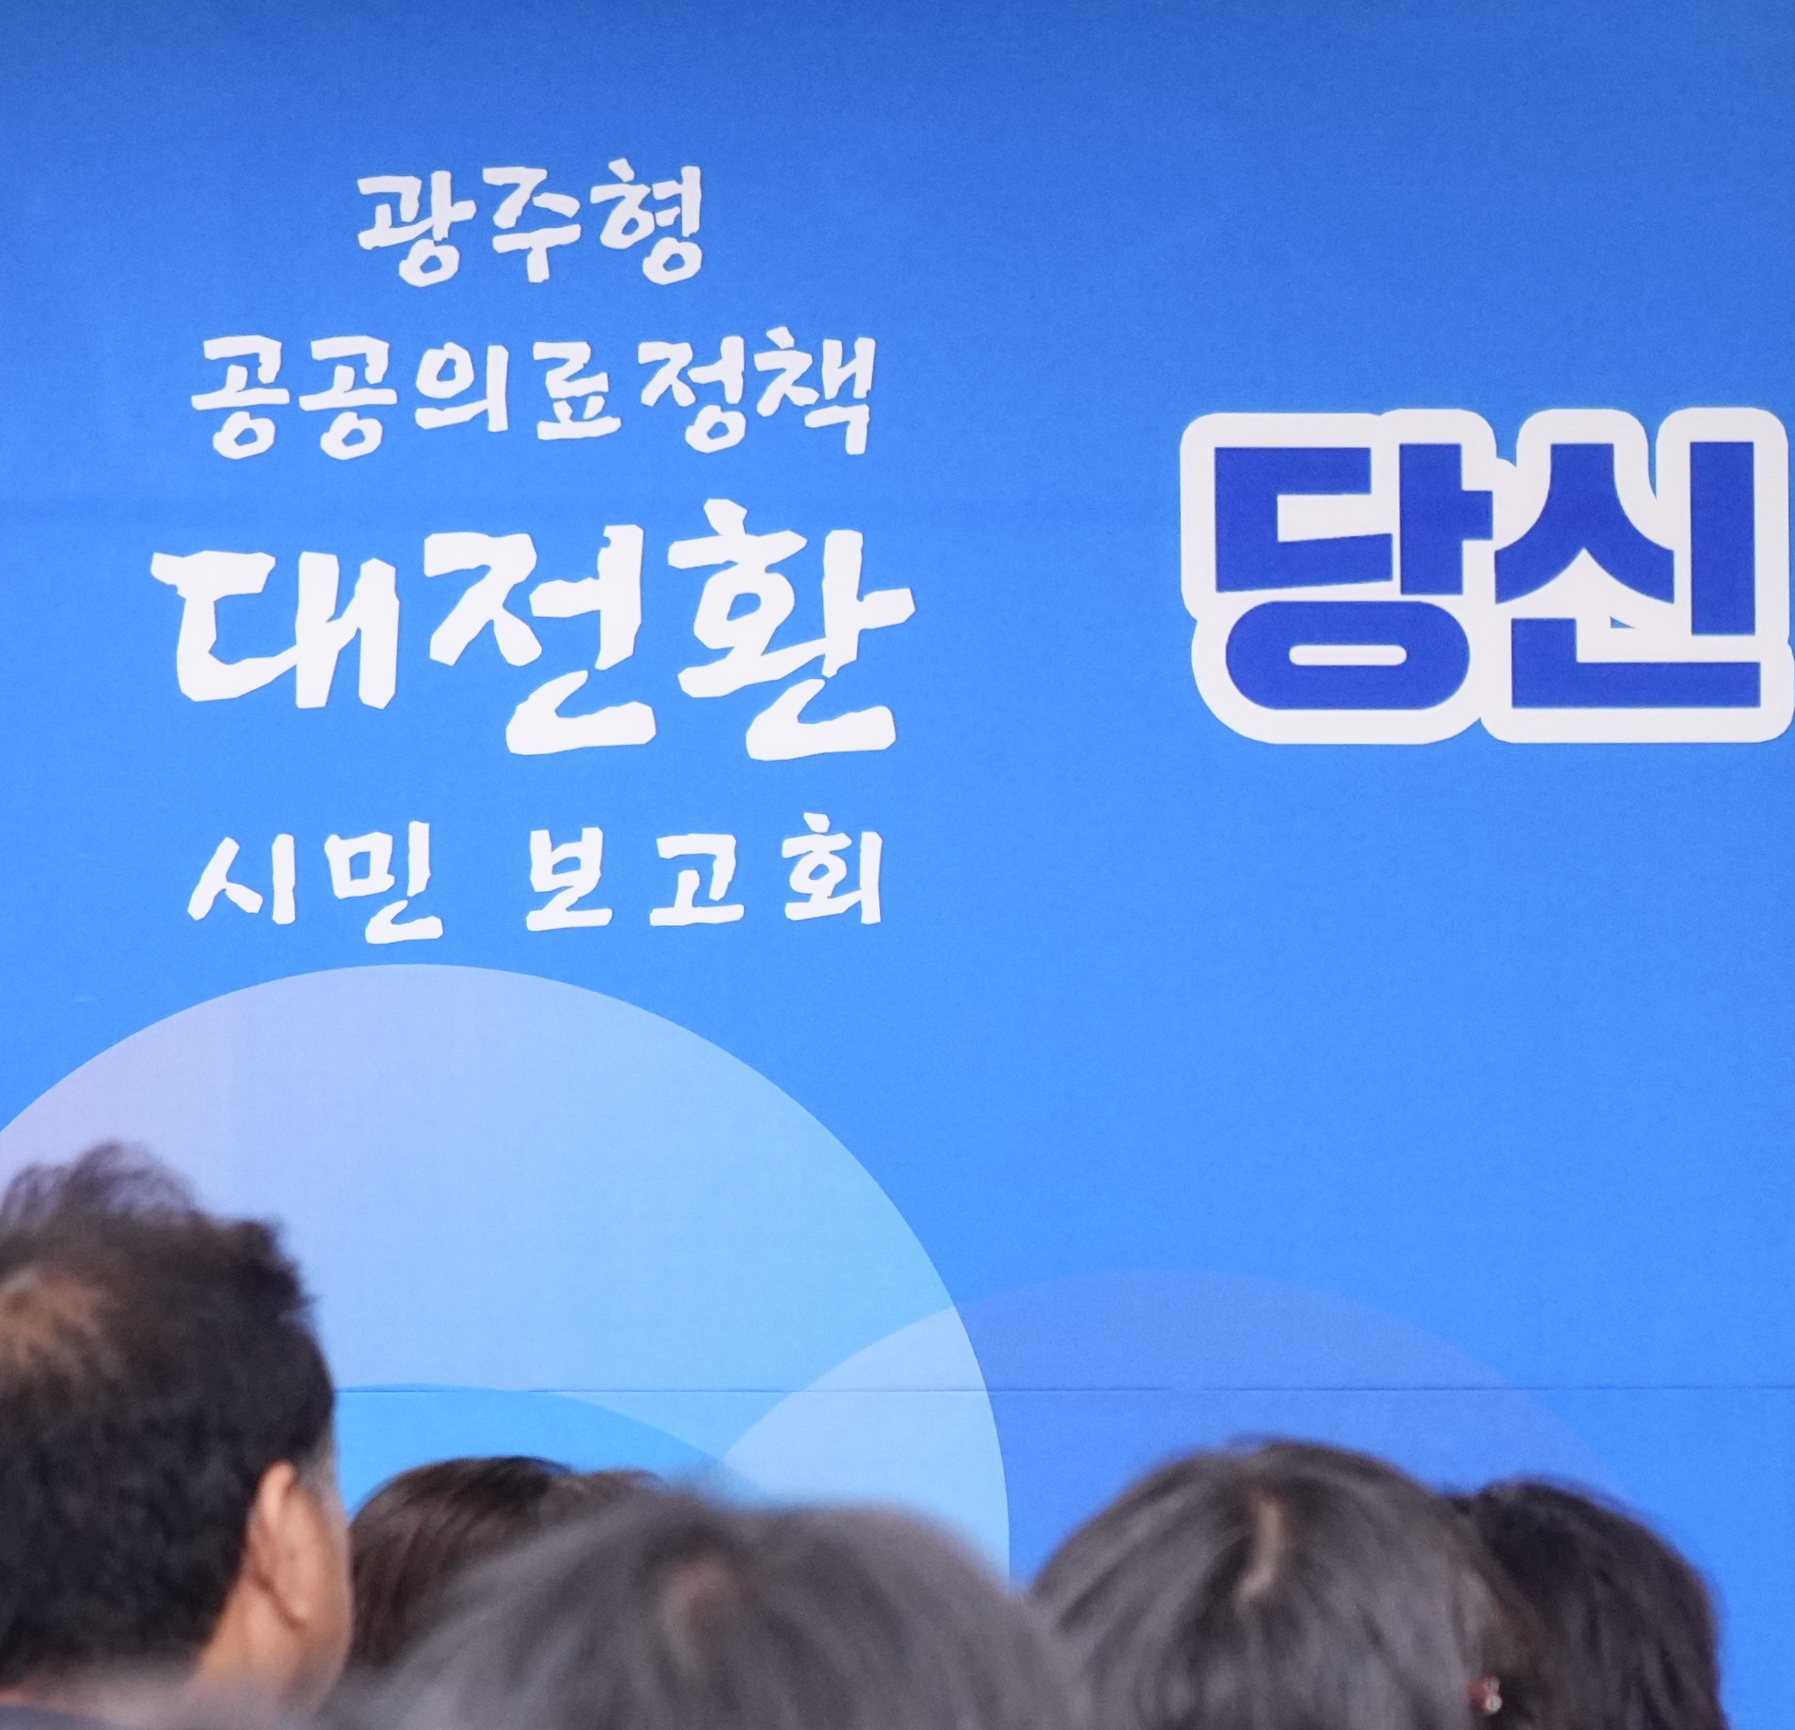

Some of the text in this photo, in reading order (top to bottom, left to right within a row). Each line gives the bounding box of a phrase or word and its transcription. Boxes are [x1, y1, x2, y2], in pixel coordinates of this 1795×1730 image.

[357, 158, 703, 288] 광주형
[191, 326, 876, 461] 공공의료정책
[150, 498, 916, 762] 대전환
[1215, 441, 1760, 710] 당신
[187, 812, 883, 945] 시민 보고회
